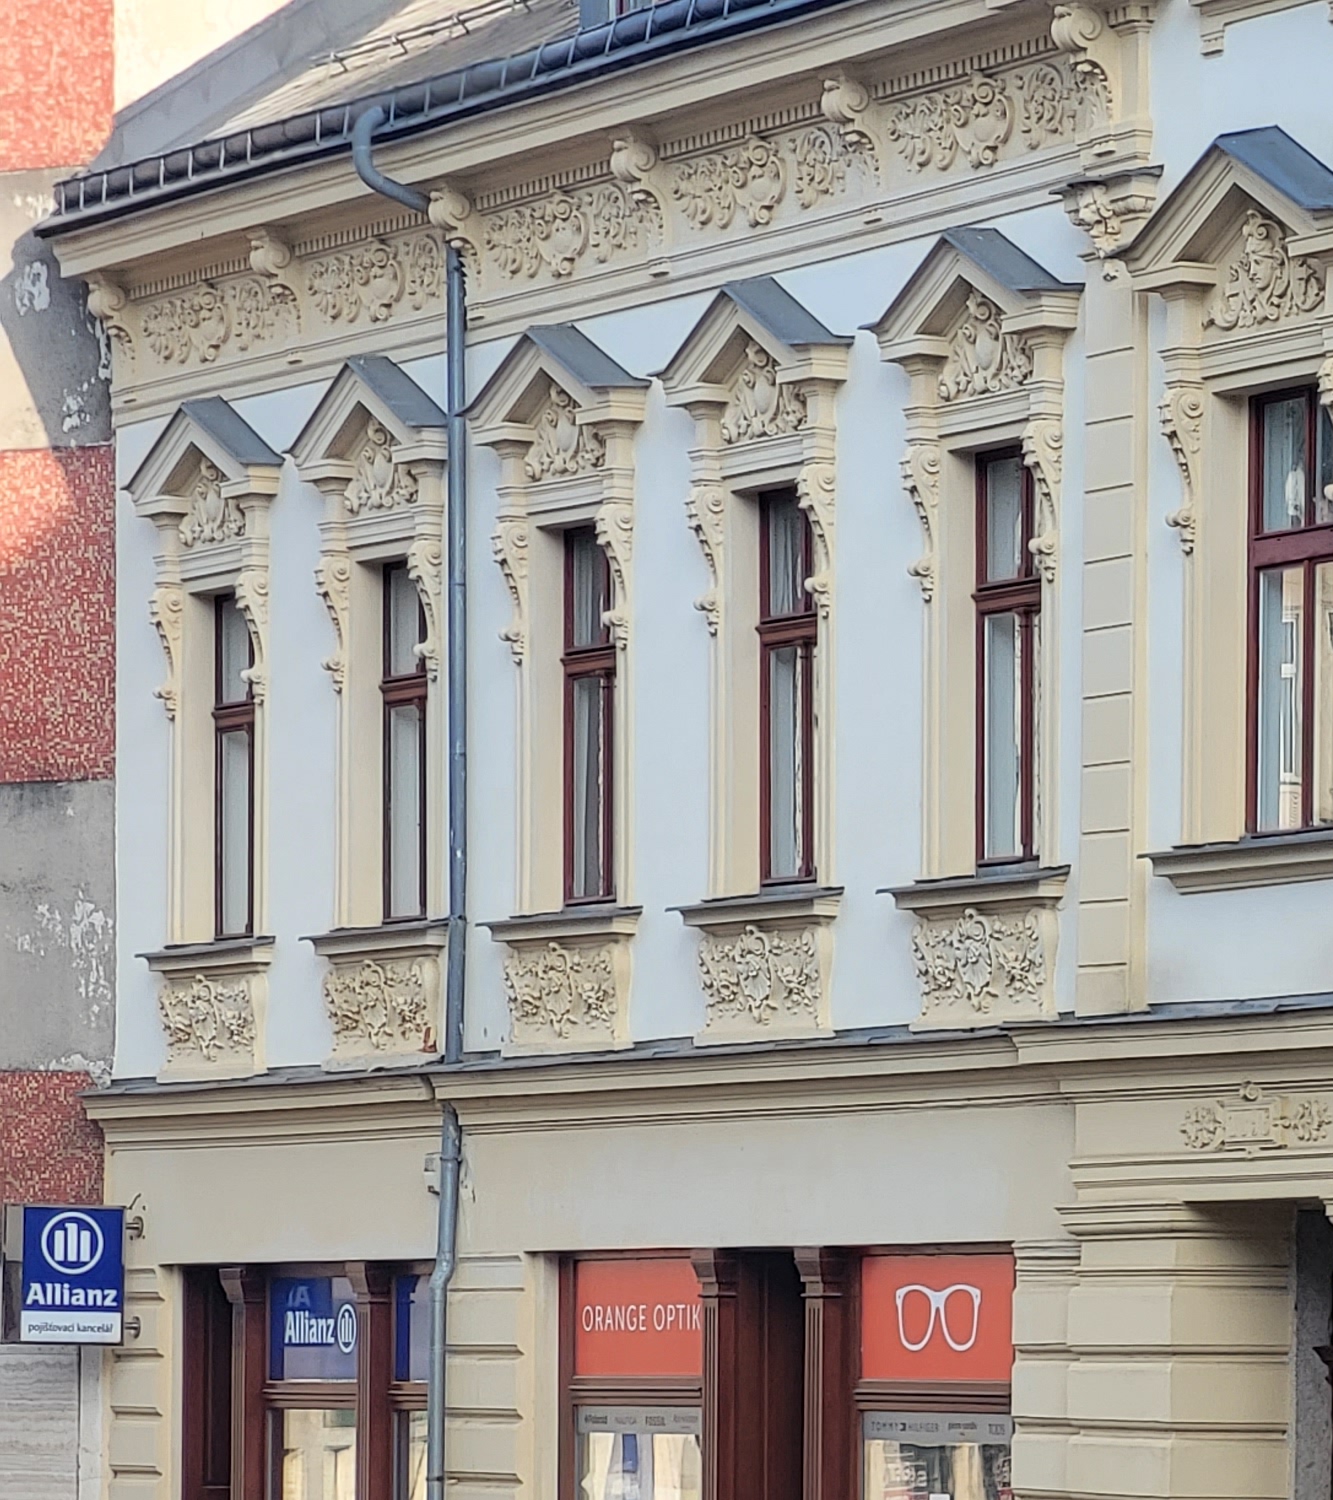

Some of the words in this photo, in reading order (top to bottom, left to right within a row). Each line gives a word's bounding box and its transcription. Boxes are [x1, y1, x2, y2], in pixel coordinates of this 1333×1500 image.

[26, 1282, 118, 1307] Allianz
[28, 1321, 74, 1335] pojišťovací
[77, 1322, 114, 1334] kancelář
[284, 1311, 336, 1345] Allianz
[582, 1304, 647, 1332] ORANGE
[653, 1303, 701, 1331] OPTIK
